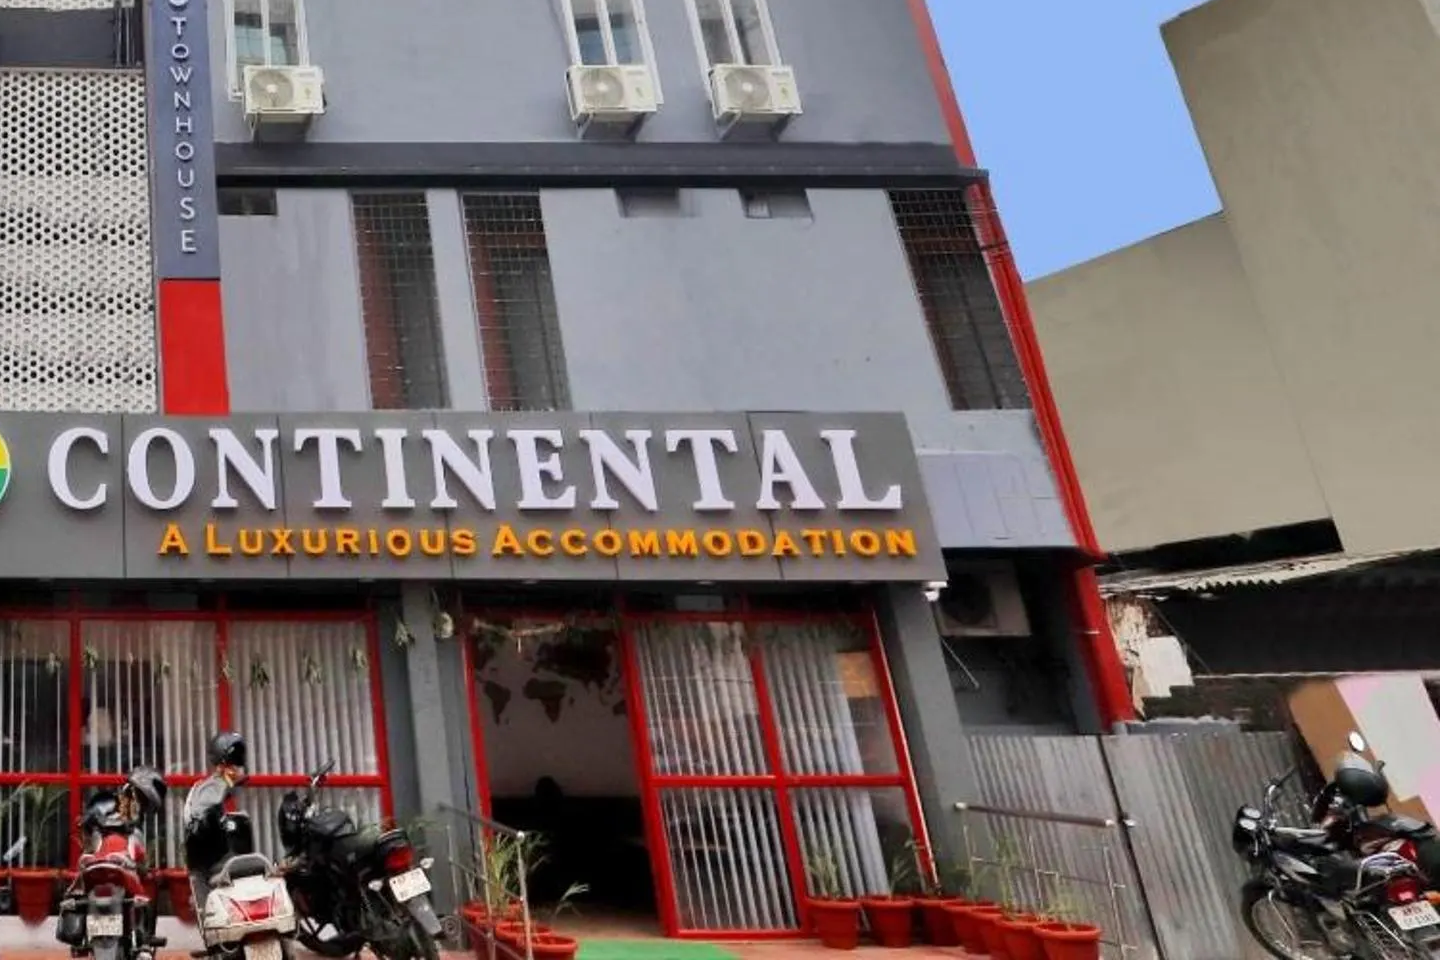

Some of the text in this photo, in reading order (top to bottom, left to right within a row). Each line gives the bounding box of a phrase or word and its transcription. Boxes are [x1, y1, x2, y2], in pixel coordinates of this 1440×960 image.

[169, 15, 198, 254] TOWNHOUSE
[47, 426, 903, 511] CONTINENTAL
[159, 523, 918, 558] A LUXURIOUS ACCOMMODATION
